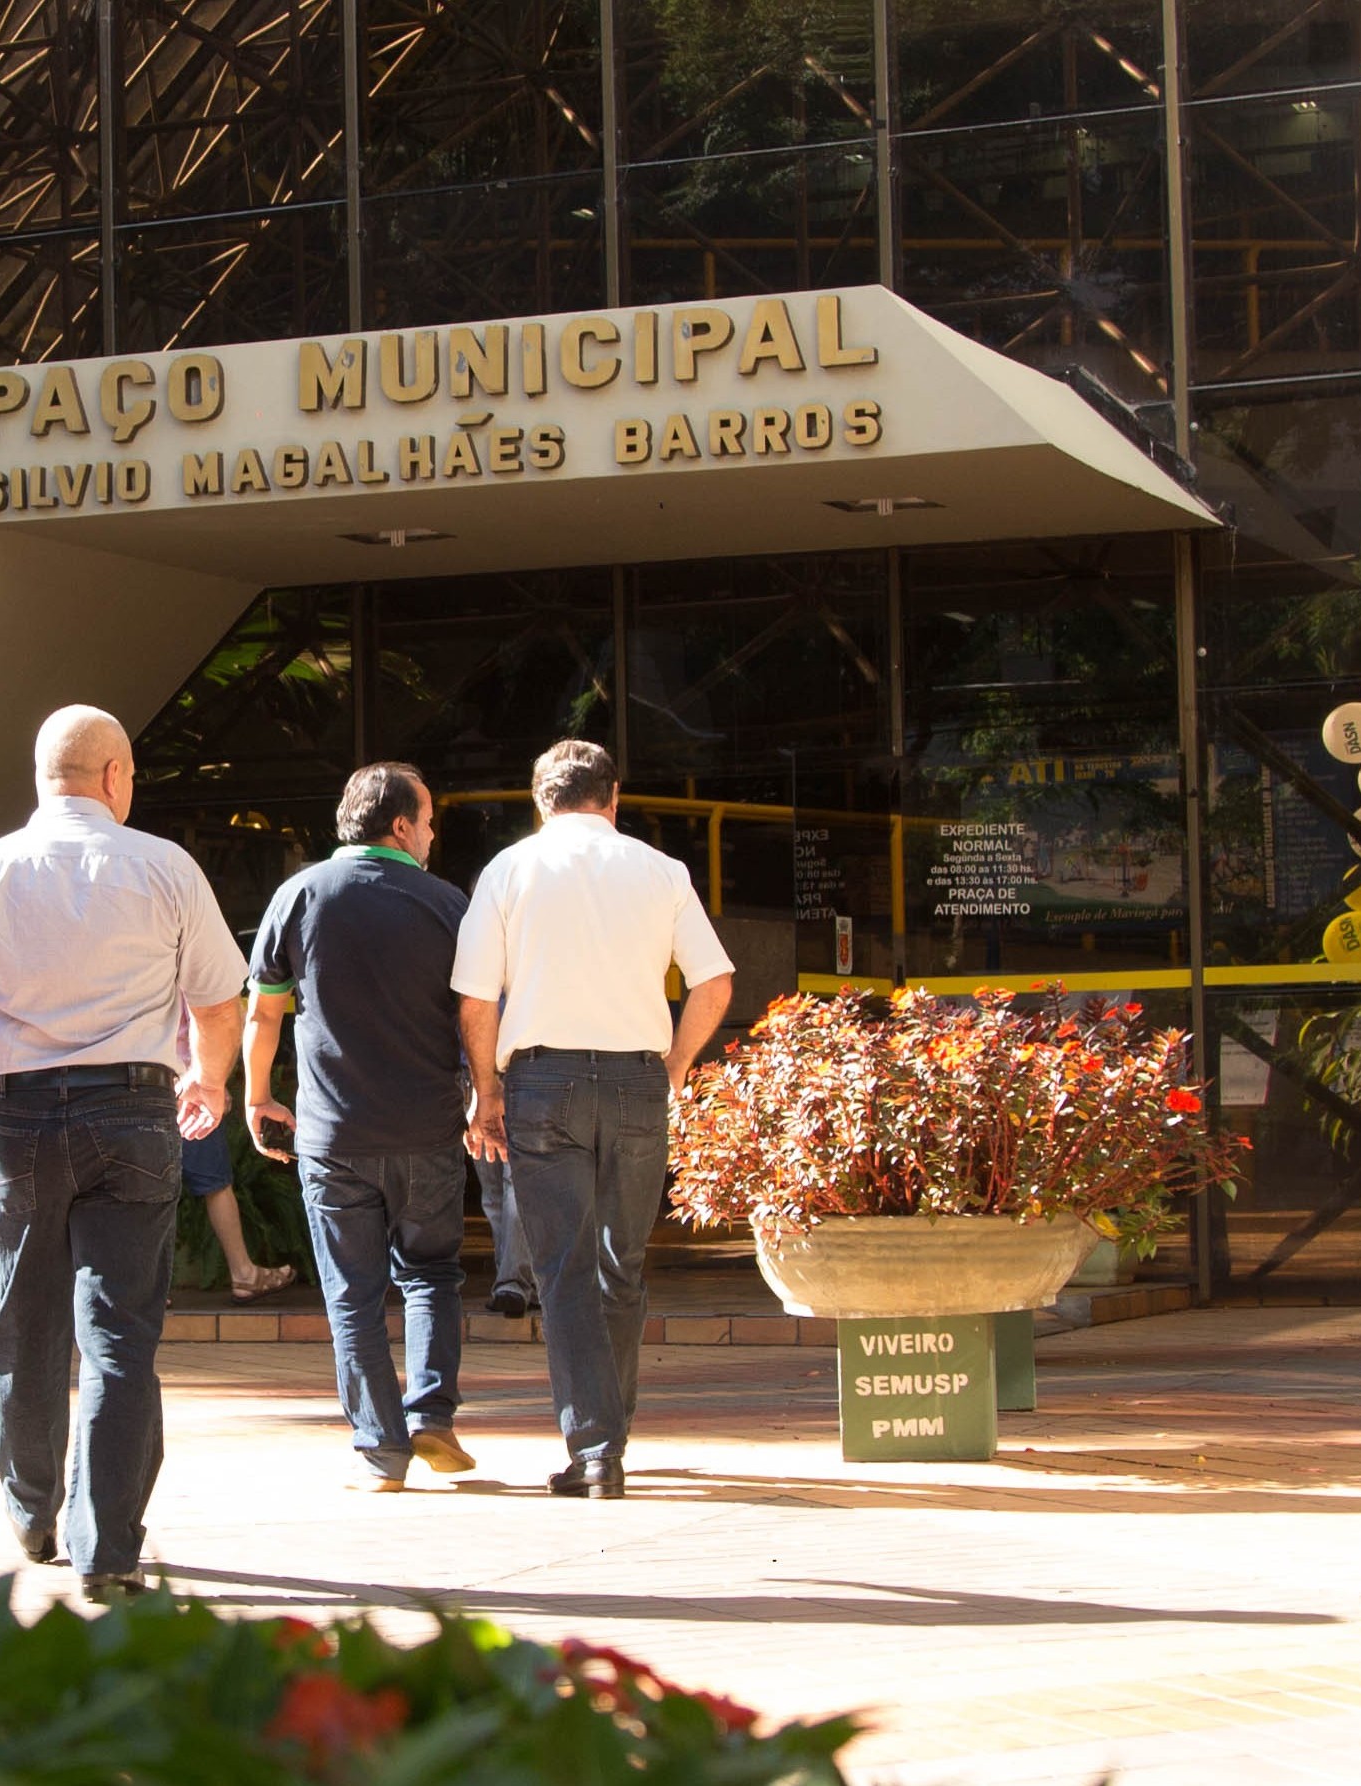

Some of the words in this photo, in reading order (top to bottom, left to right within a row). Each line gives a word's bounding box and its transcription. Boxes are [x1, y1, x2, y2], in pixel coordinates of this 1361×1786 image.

[296, 293, 878, 412] MUNICIPAL
[182, 411, 565, 496] MAGALHÃES
[614, 400, 882, 465] BARROS
[940, 823, 1025, 836] EXPEDIENTE
[953, 840, 1013, 852] NORMAL
[995, 853, 1022, 862] Sexta
[930, 865, 948, 874] das
[950, 865, 976, 874] 08:00
[992, 864, 1018, 873] 11:30
[935, 877, 952, 886] das
[955, 876, 980, 885] 13:30
[997, 876, 1023, 885] 17:00
[949, 888, 995, 902] PRAÇA
[998, 888, 1016, 899] DE
[934, 902, 1031, 915] ATENDIMENTO
[859, 1333, 954, 1356] VIVEIRO
[855, 1373, 969, 1396] SEMUSP
[872, 1416, 944, 1439] PMM
